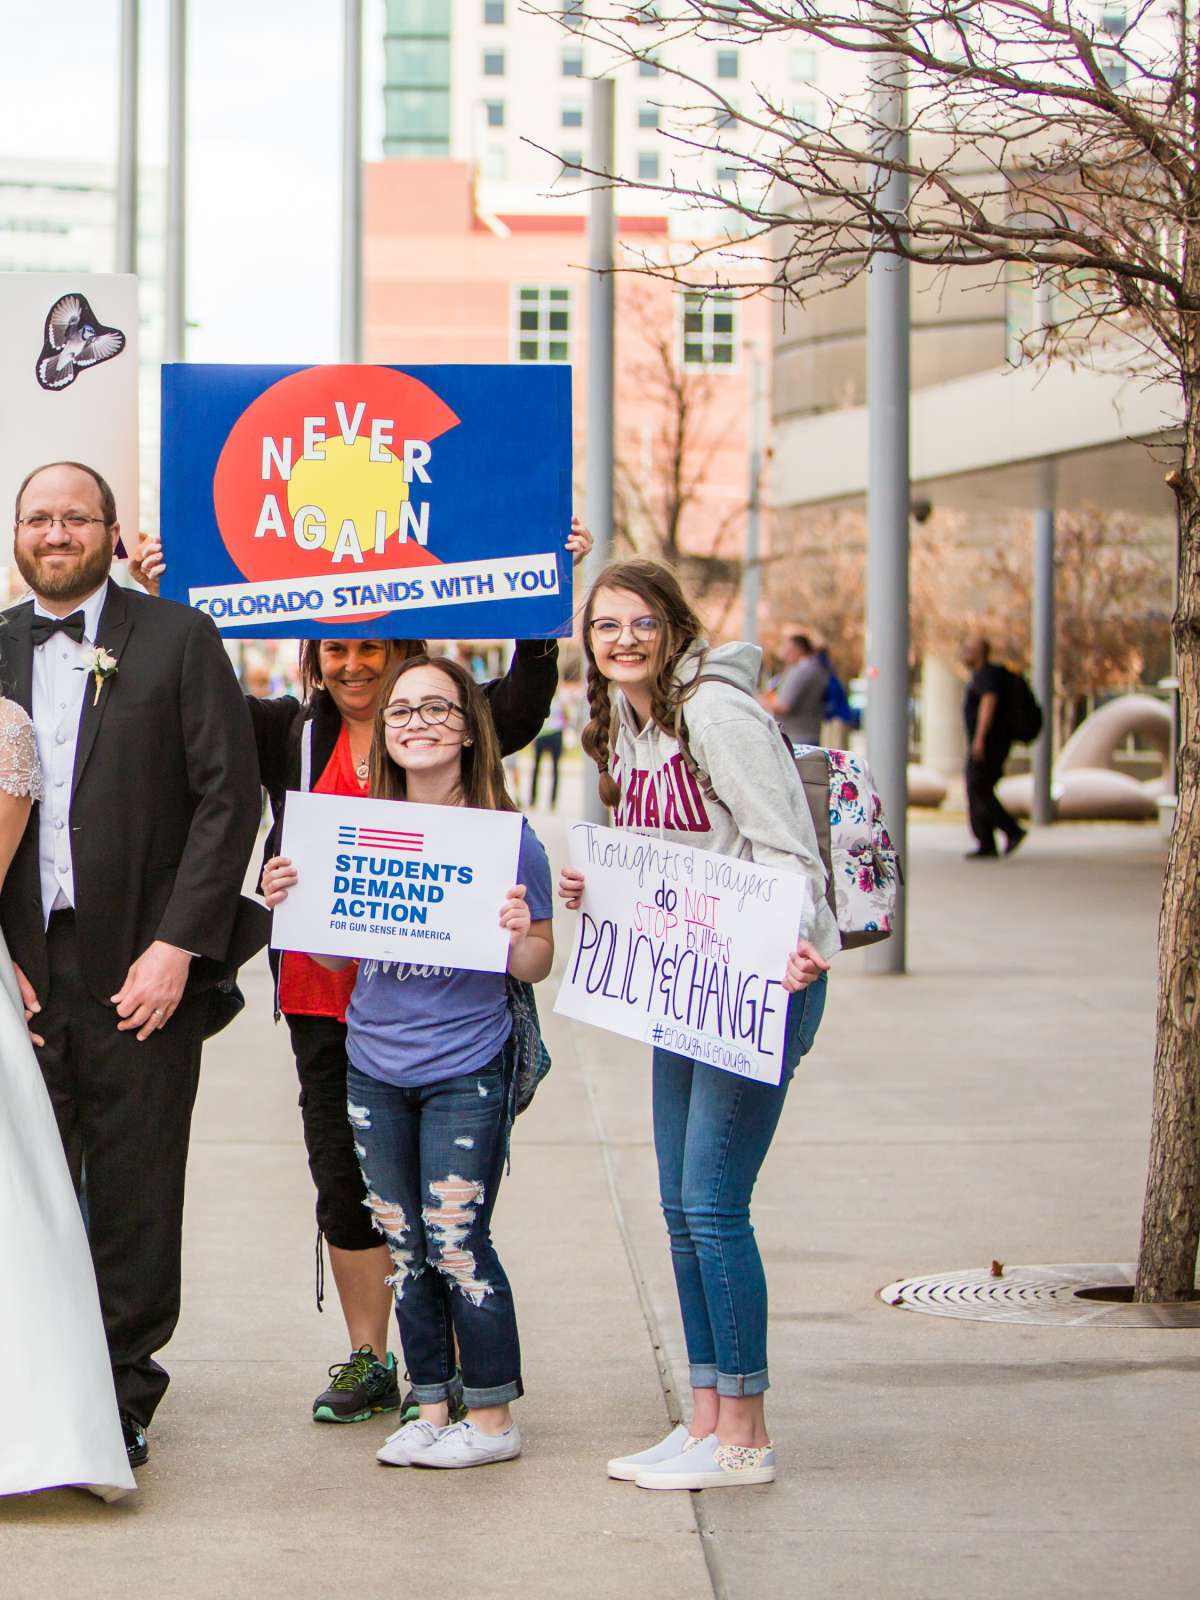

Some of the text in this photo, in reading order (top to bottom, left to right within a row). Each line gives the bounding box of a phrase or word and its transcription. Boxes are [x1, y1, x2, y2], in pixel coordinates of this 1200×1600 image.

[261, 401, 432, 483] NEVER
[254, 494, 430, 564] AGAIN
[333, 579, 424, 608] STANDS
[432, 574, 494, 600] WITH
[504, 569, 557, 592] YOU
[333, 876, 444, 903] DEMAND
[335, 854, 473, 885] STUDENTS
[571, 824, 680, 888] Thoughts
[704, 859, 779, 912] prayers
[330, 898, 427, 925] ACTION
[655, 879, 720, 928] do NOT
[330, 920, 452, 941] FOR GUN SENSE IN AMERICA
[635, 901, 732, 965] STOP bullets
